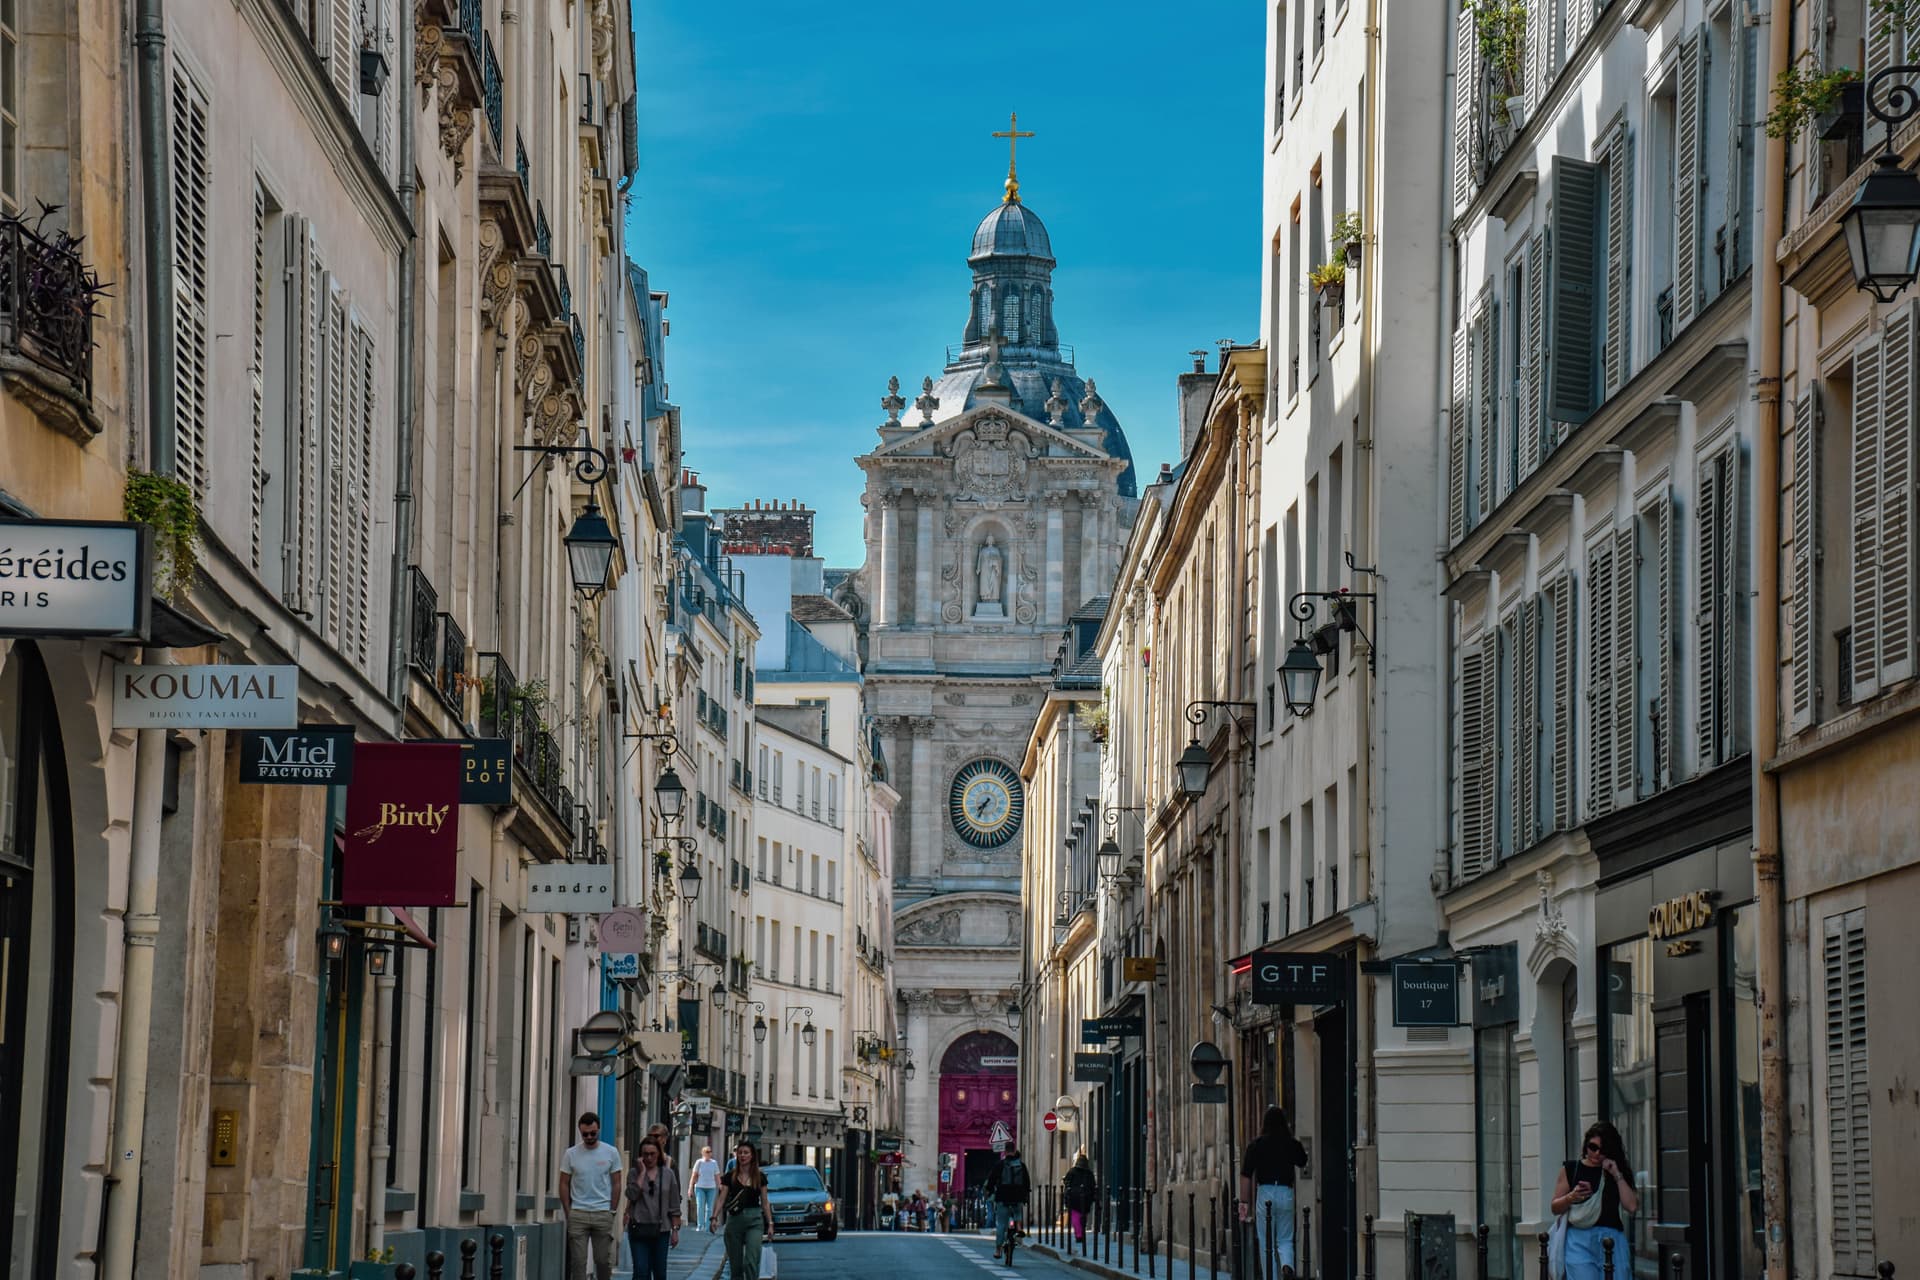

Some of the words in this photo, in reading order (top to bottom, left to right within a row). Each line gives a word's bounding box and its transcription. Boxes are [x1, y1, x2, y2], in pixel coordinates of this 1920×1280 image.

[0, 545, 127, 582] éréides
[1, 591, 49, 608] RIS
[124, 673, 285, 700] KOUMAL
[150, 711, 192, 719] BIJOUX
[257, 736, 336, 765] Miel
[466, 759, 505, 770] DIE
[258, 767, 334, 778] FACTORY
[466, 772, 505, 783] LOT
[379, 802, 450, 834] Birdy
[531, 883, 608, 893] sandro
[1647, 888, 1712, 941] COURTOIS
[1260, 964, 1328, 983] GTF
[1403, 980, 1449, 992] boutique
[1421, 1000, 1433, 1009] 17
